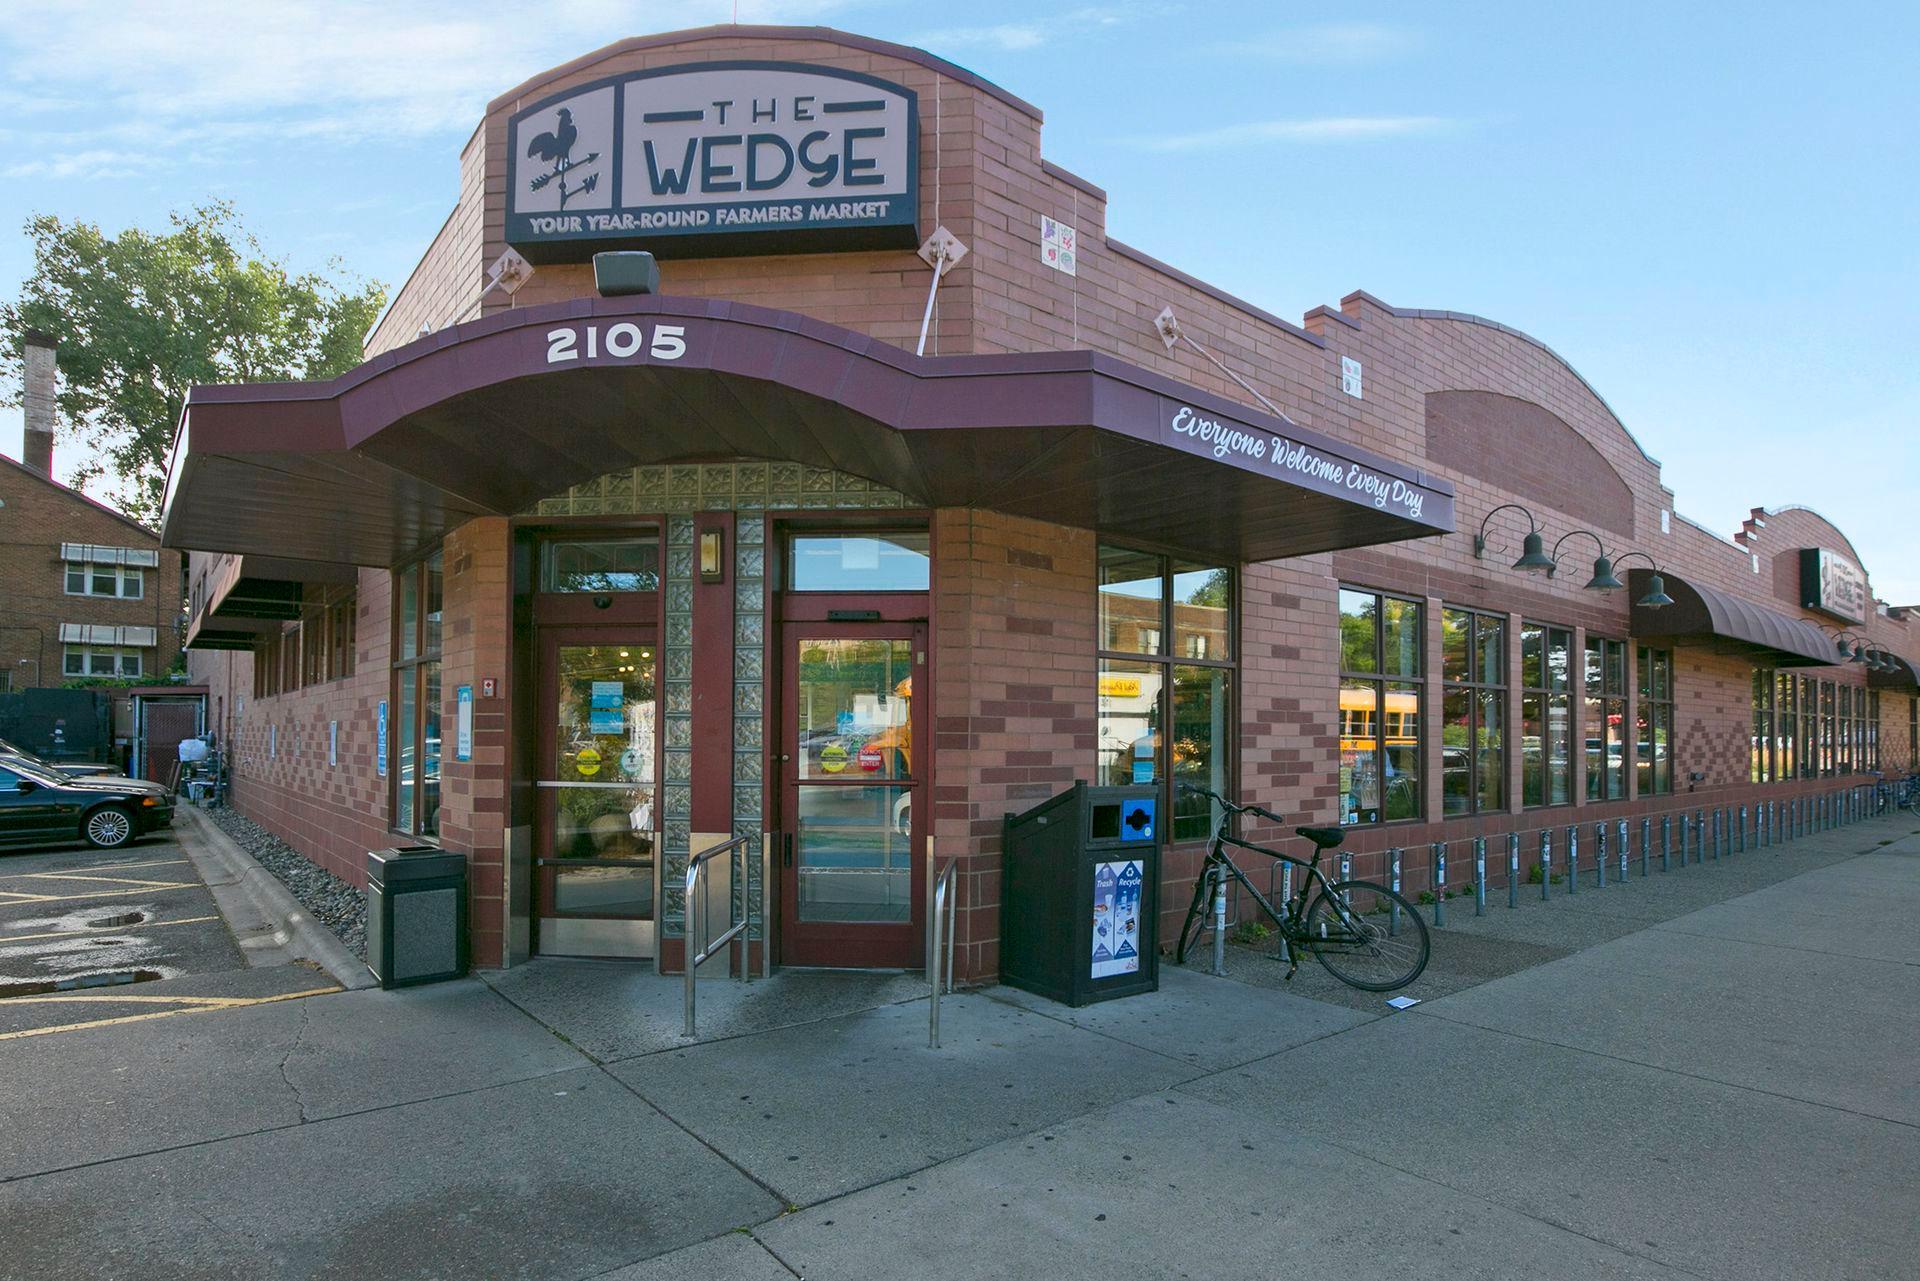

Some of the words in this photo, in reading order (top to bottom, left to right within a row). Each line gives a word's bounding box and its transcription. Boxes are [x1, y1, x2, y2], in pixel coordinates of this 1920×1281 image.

[713, 96, 815, 125] THE
[642, 127, 887, 195] WEDGE
[529, 216, 583, 234] YOUR
[586, 210, 710, 232] YEAR-ROUND
[716, 205, 803, 225] FARMERS
[808, 201, 890, 221] MARKET
[547, 322, 687, 363] 2105
[1172, 407, 1266, 457] Everyone
[1271, 436, 1343, 484] Welcome
[1346, 464, 1391, 508] Every
[1392, 480, 1423, 518] Day
[1097, 879, 1113, 888] Trash
[1118, 877, 1141, 888] Recycle
